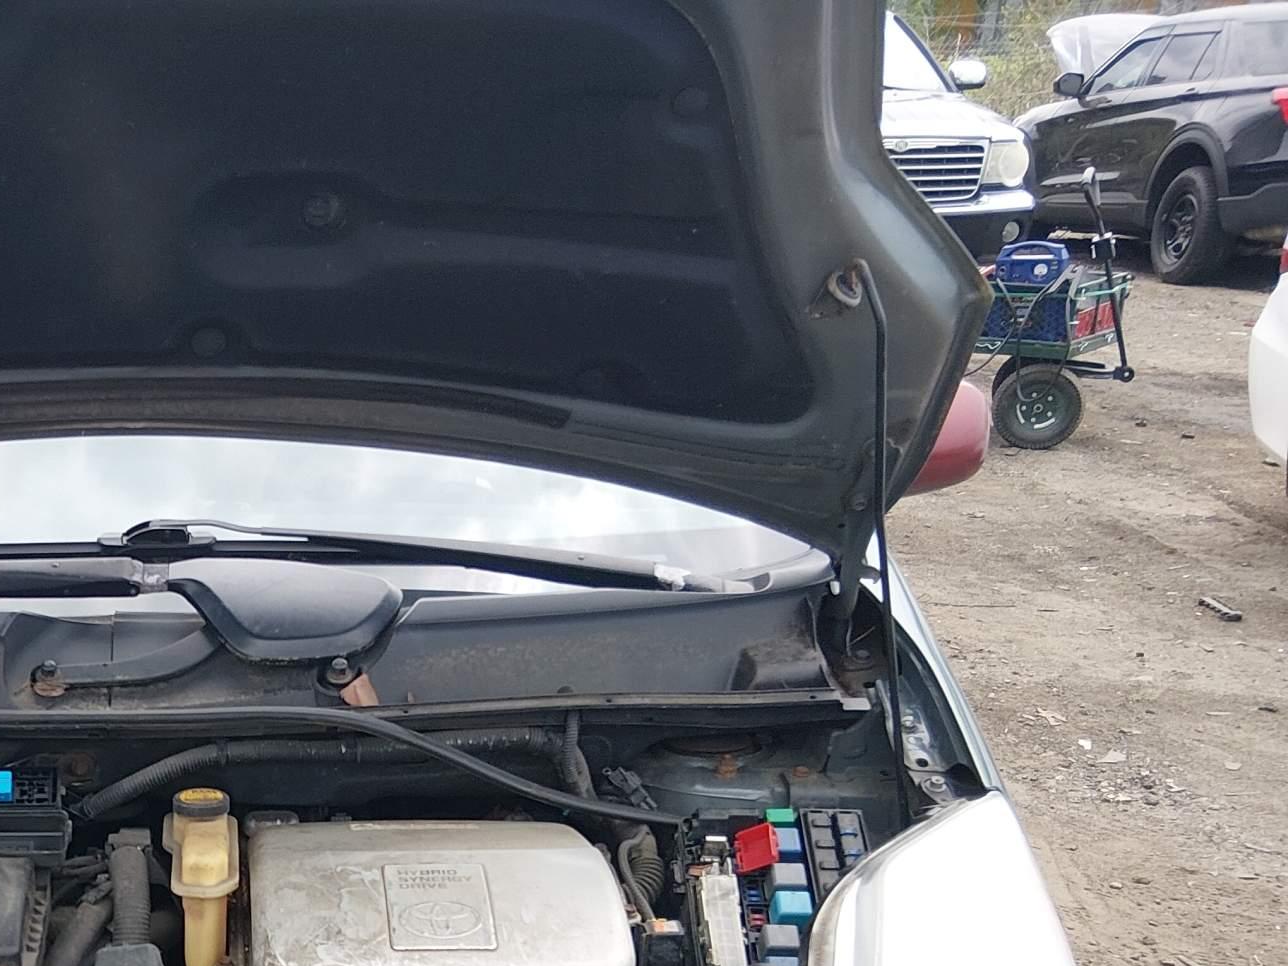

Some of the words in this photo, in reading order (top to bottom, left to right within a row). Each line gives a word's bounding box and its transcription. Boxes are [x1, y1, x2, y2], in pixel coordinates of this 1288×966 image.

[396, 868, 458, 876] HYBRID
[397, 875, 473, 883] SYNERGY
[399, 882, 449, 890] DRIVE
